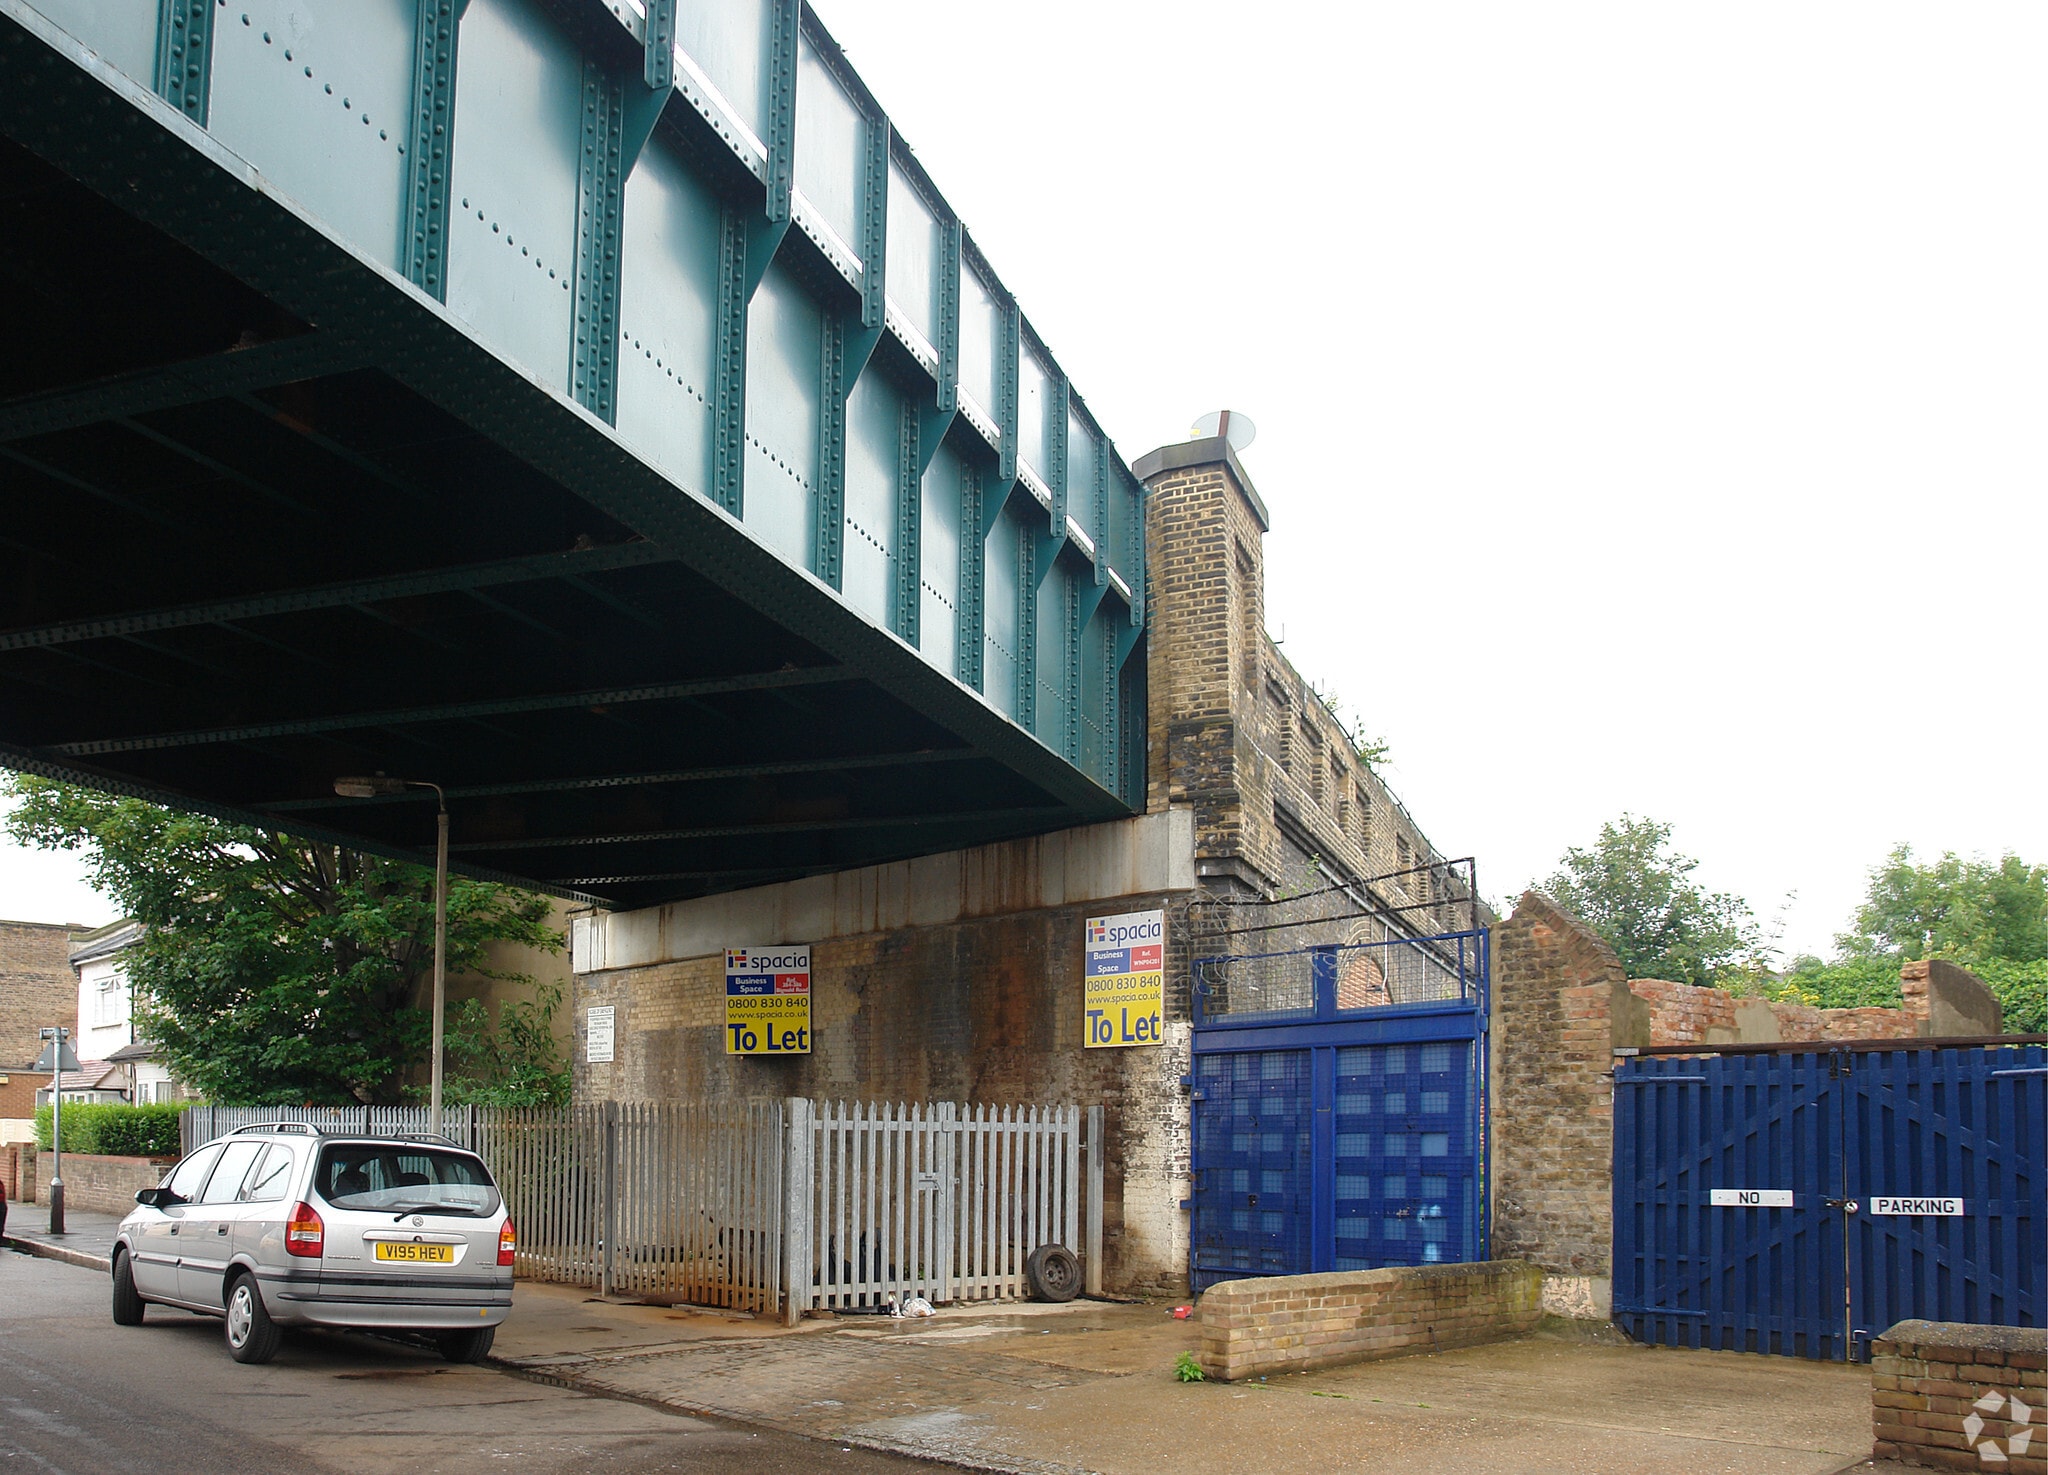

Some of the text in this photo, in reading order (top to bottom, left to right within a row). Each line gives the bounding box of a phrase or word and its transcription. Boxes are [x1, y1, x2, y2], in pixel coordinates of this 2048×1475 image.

[1109, 919, 1161, 947] spacia
[751, 952, 808, 973] spacia
[1093, 951, 1124, 960] Business
[1097, 965, 1119, 975] Space
[735, 977, 767, 985] Business
[1087, 975, 1161, 992] 0800 830 840
[739, 985, 763, 994] Space
[1087, 990, 1161, 1004] www.spacia.co.uk
[728, 997, 808, 1009] 0800 830 840
[728, 1010, 808, 1020] www.spacia.co.uk
[1087, 1007, 1160, 1043] To Let
[728, 1022, 808, 1051] To Let
[1738, 1191, 1955, 1214] NO PARKING
[385, 1244, 446, 1260] V195 HEV
